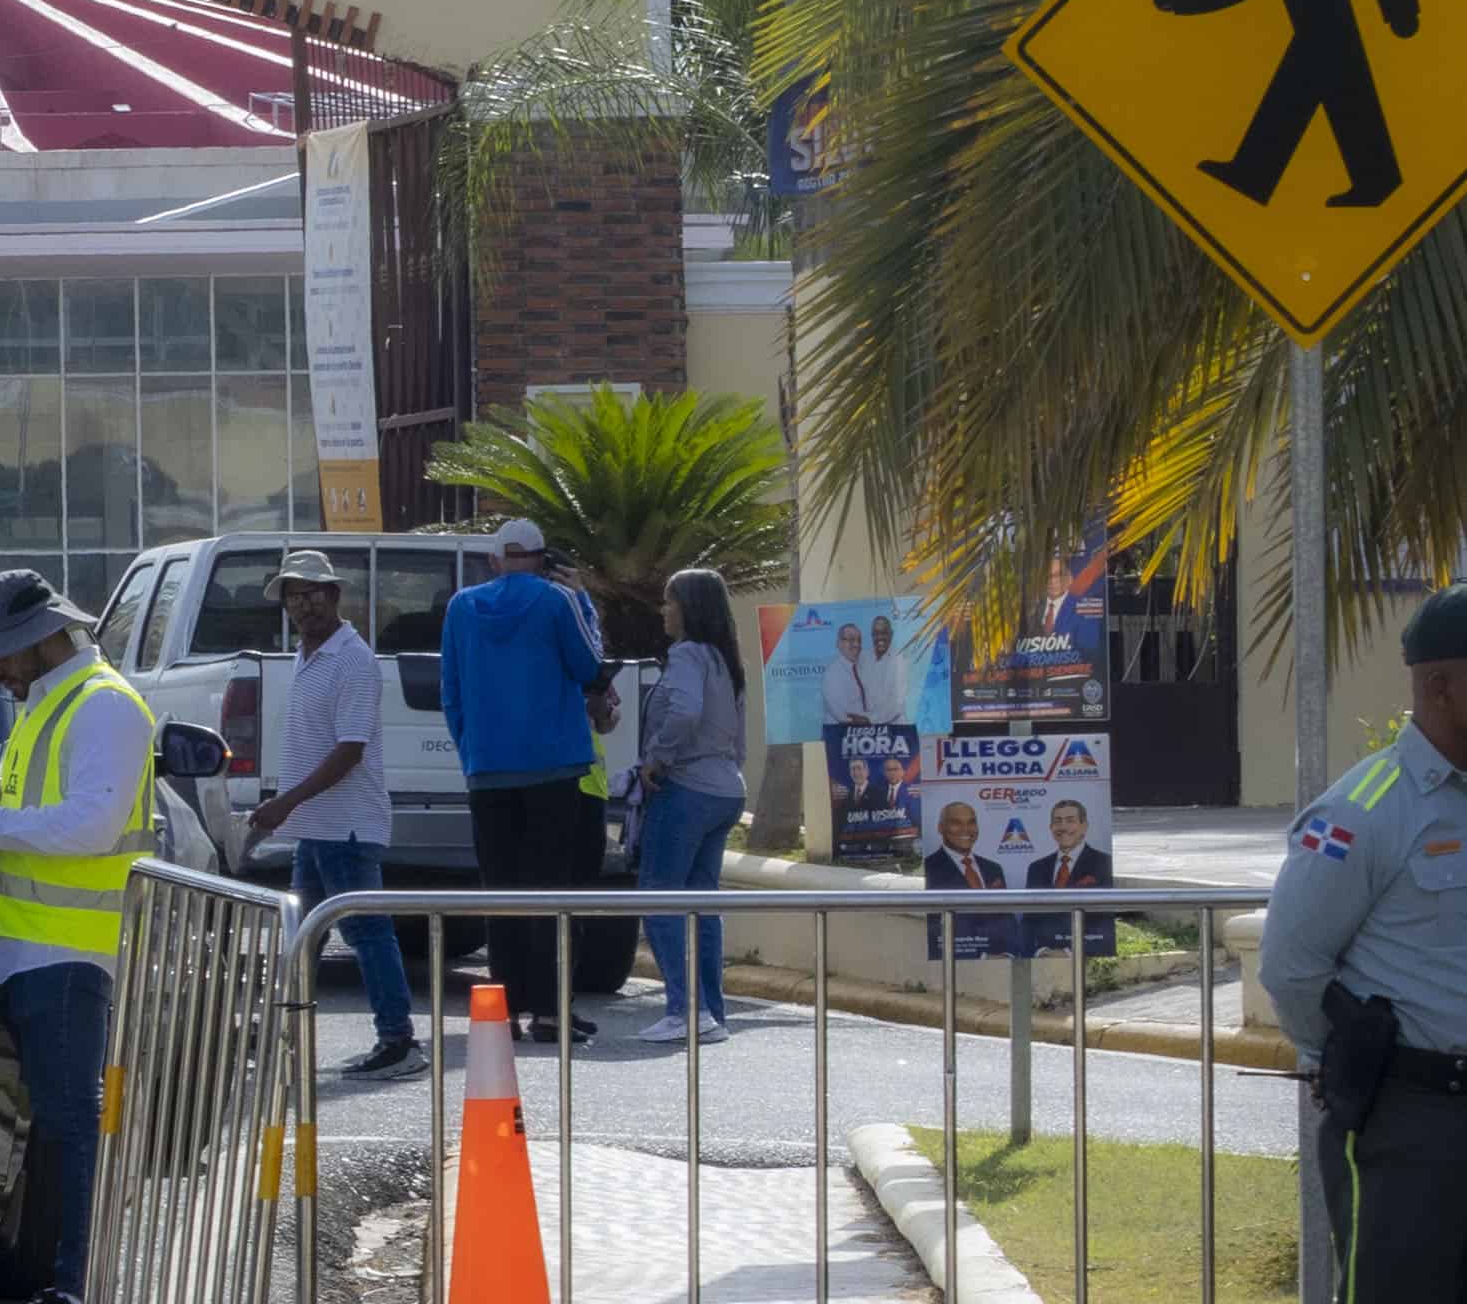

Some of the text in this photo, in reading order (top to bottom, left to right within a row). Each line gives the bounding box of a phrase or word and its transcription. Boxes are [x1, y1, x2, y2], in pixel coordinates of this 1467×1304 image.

[841, 736, 910, 755] HORA
[947, 760, 1043, 776] LA HORA
